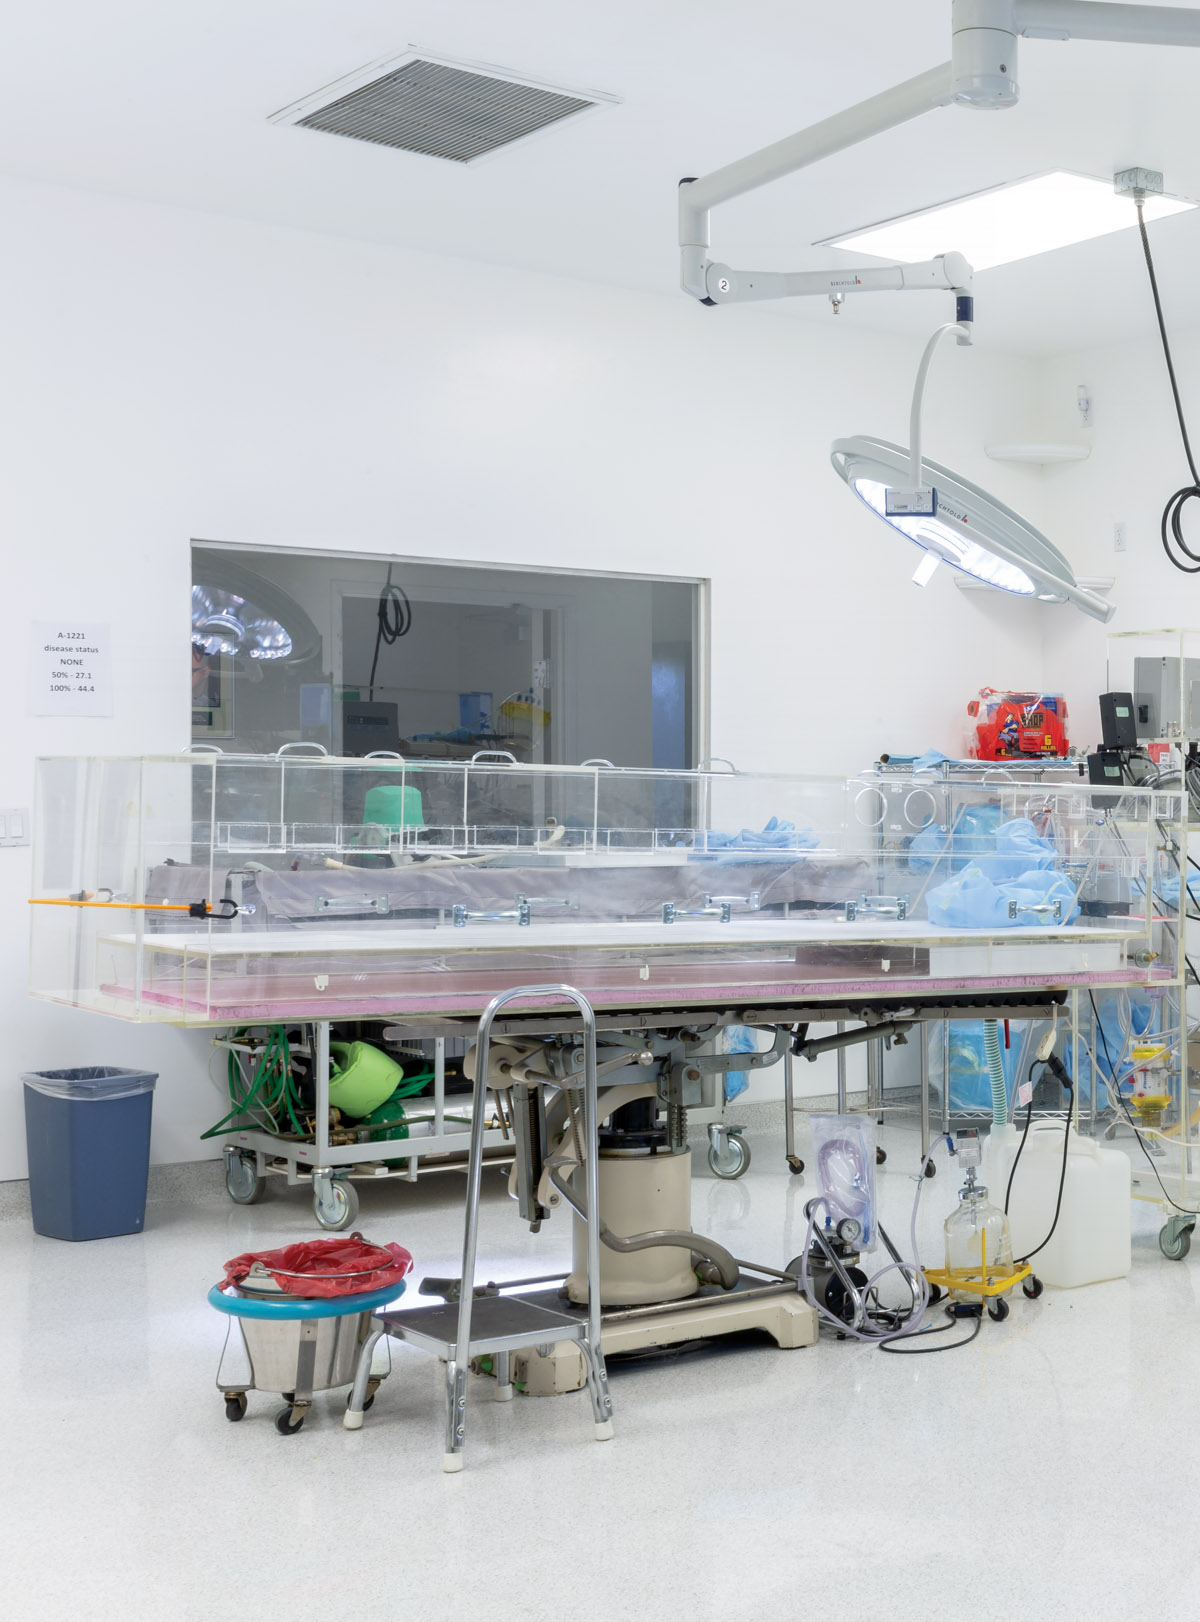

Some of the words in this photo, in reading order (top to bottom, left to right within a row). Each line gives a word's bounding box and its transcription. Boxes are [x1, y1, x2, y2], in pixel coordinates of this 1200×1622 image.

[721, 280, 728, 291] 2
[937, 502, 962, 519] CHTOLD
[57, 632, 86, 640] A-1221
[44, 644, 74, 652] disease
[60, 658, 84, 666] NONE
[51, 671, 69, 679] 50%
[75, 672, 92, 680] 27.1
[50, 684, 71, 692] 100%
[1044, 734, 1052, 746] 6
